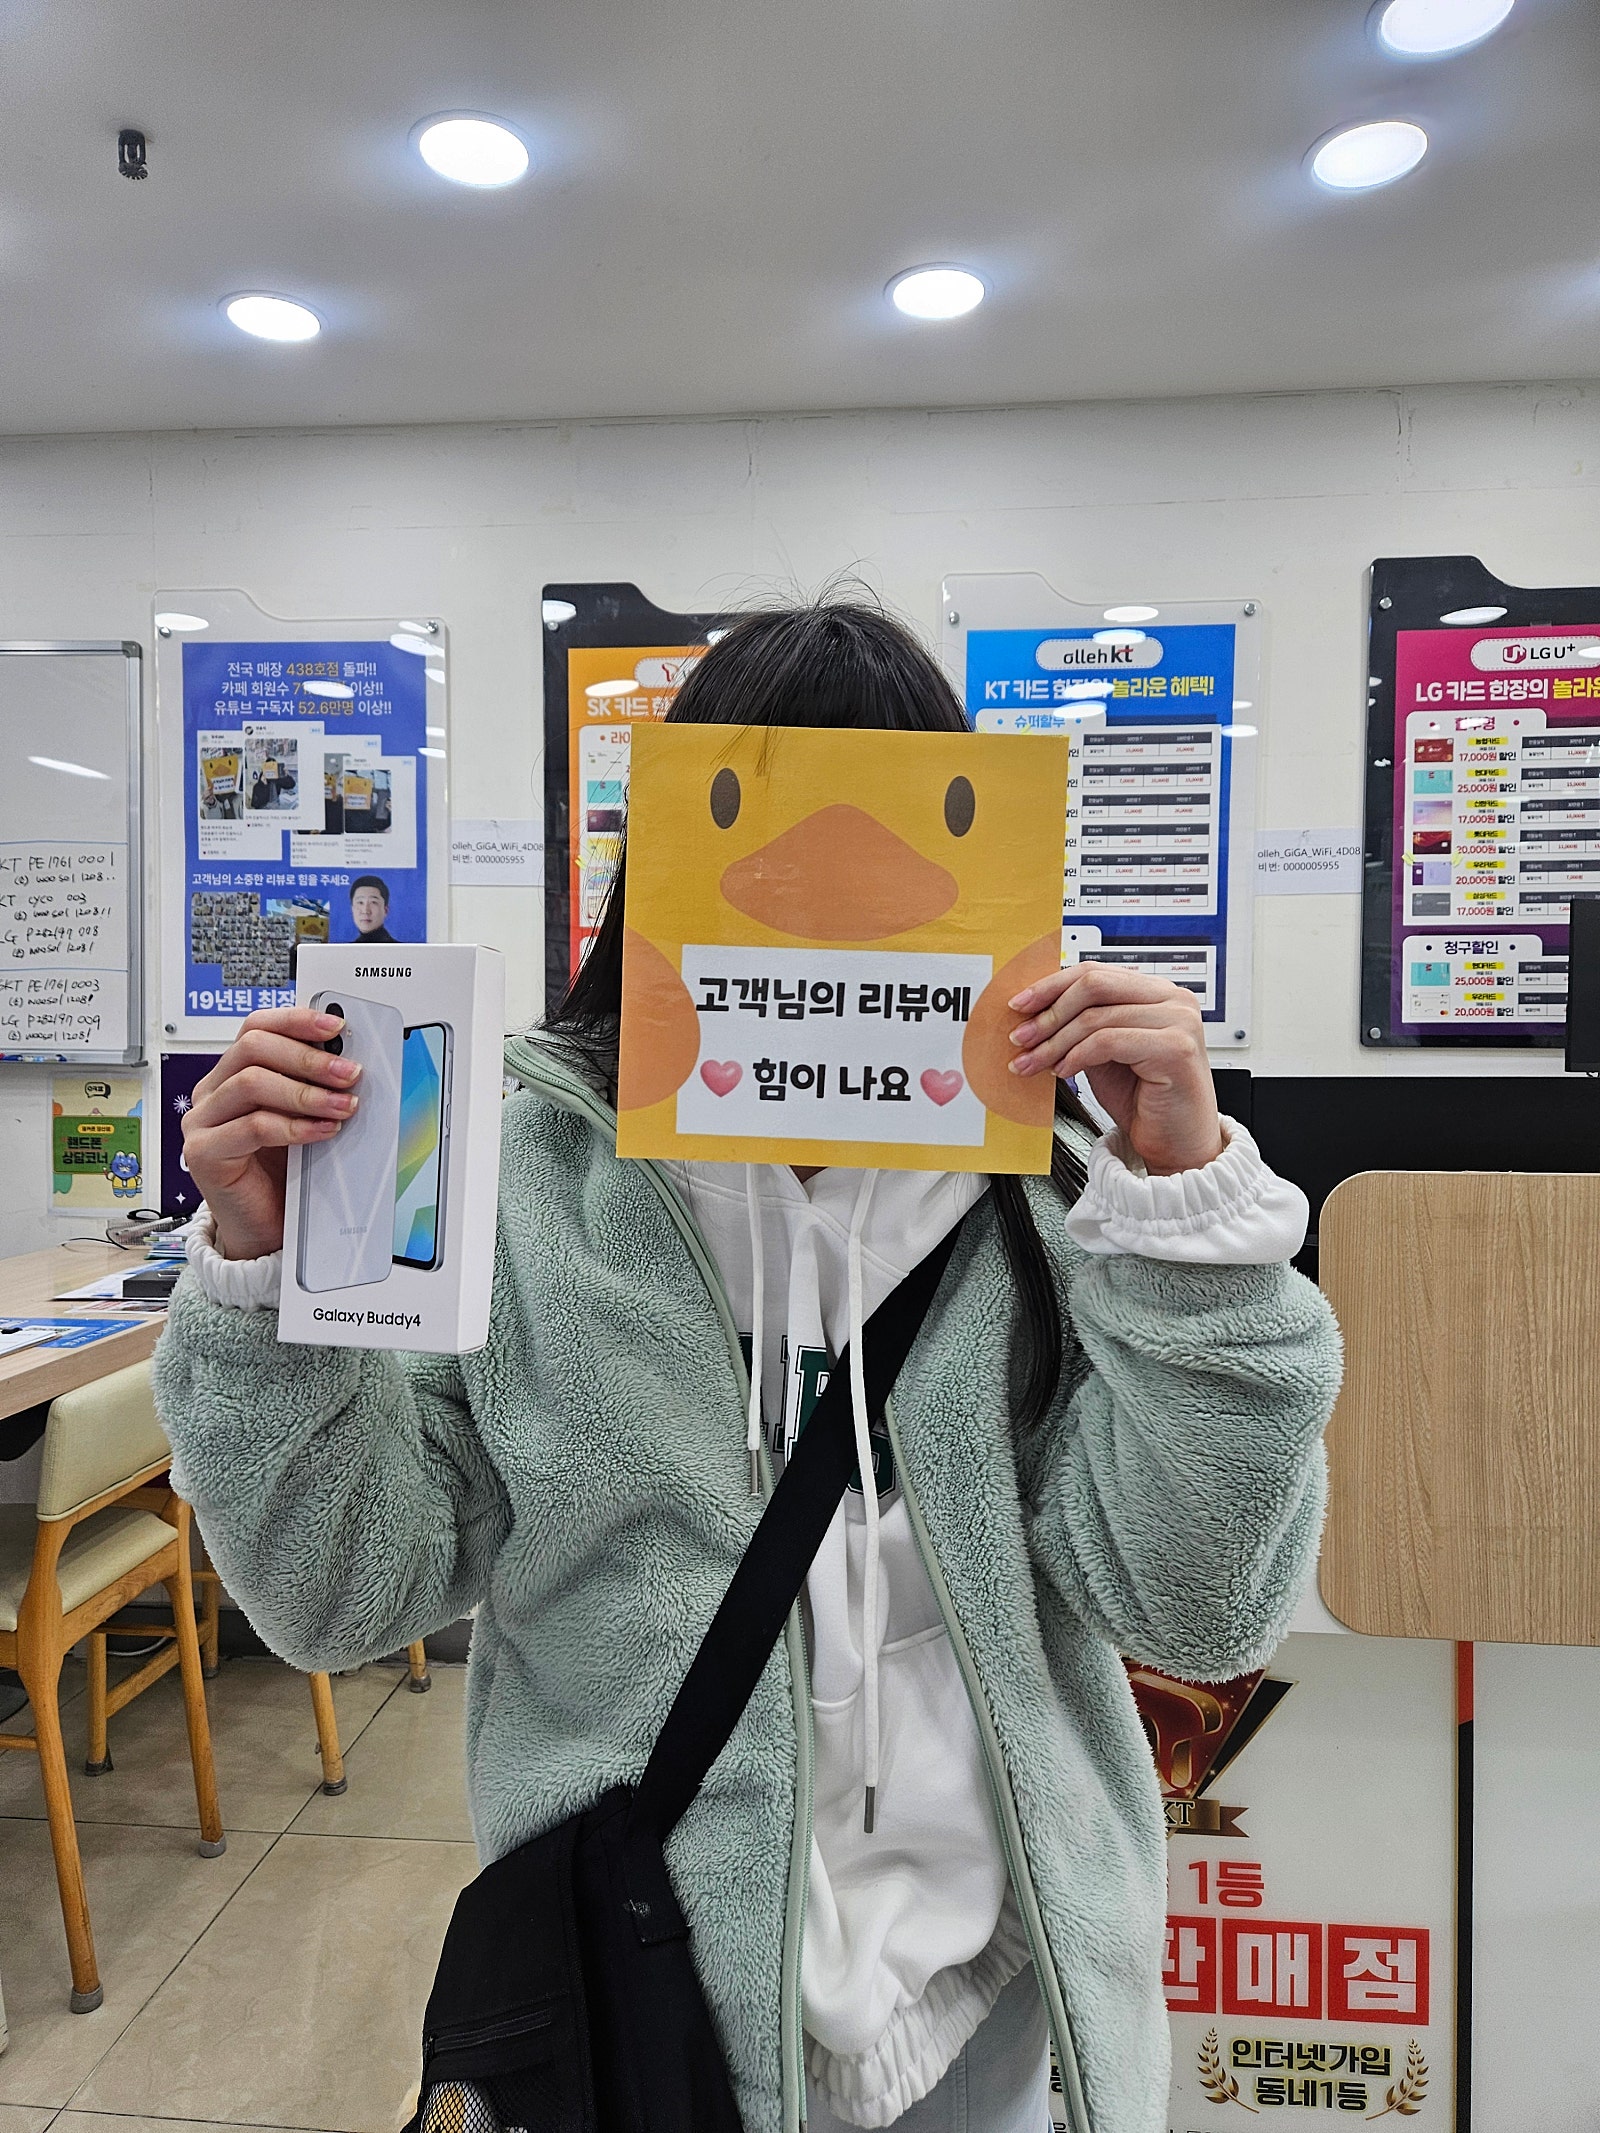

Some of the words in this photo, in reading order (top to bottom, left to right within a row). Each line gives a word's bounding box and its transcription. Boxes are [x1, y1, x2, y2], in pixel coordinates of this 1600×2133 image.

[1530, 646, 1551, 660] LG
[227, 662, 253, 677] 전국
[257, 662, 283, 677] 매장
[286, 661, 340, 677] 438호점
[343, 661, 377, 677] 돌파!!
[221, 682, 248, 697] 카페
[251, 682, 290, 697] 회원수
[351, 681, 384, 696] 이상!!
[984, 680, 1010, 700] KT
[1013, 679, 1049, 700] 카드
[1112, 677, 1167, 699] 놀라운
[1170, 676, 1214, 697] 혜택!
[1415, 682, 1442, 702] LG
[1446, 681, 1485, 701] 카드
[1489, 678, 1549, 701] 한장의
[214, 701, 253, 716] 유튜브
[256, 701, 295, 716] 구독자
[298, 700, 355, 716] 52.6만명
[358, 700, 392, 715] 이상!!
[587, 697, 611, 717] SK
[614, 696, 649, 717] 카드
[1459, 752, 1497, 762] 17,000원
[1457, 783, 1498, 793] 25,000원
[1458, 815, 1496, 824] 17,000원
[192, 873, 232, 886] 고객님의
[234, 873, 264, 886] 소중한
[266, 873, 296, 886] 리뷰로
[298, 873, 319, 887] 힘을
[321, 874, 350, 887] 주세요
[1456, 876, 1496, 885] 20,000원
[1456, 907, 1495, 916] 17,000원
[1444, 941, 1499, 955] 청구할인
[355, 966, 412, 979] SAMSUNG
[1455, 976, 1495, 986] 25,000원
[188, 988, 253, 1012] 19년된
[696, 977, 846, 1020] 고객님의
[860, 983, 971, 1022] 리뷰에
[1455, 1007, 1495, 1017] 20,000원
[752, 1058, 827, 1102] 힘이
[838, 1064, 912, 1103] 나요
[312, 1307, 364, 1327] Galaxy
[366, 1310, 421, 1330] Buddy4
[1188, 1860, 1265, 1909] 1등
[1231, 2039, 1391, 2076] 인터넷가입
[1255, 2075, 1368, 2111] 동네1등
